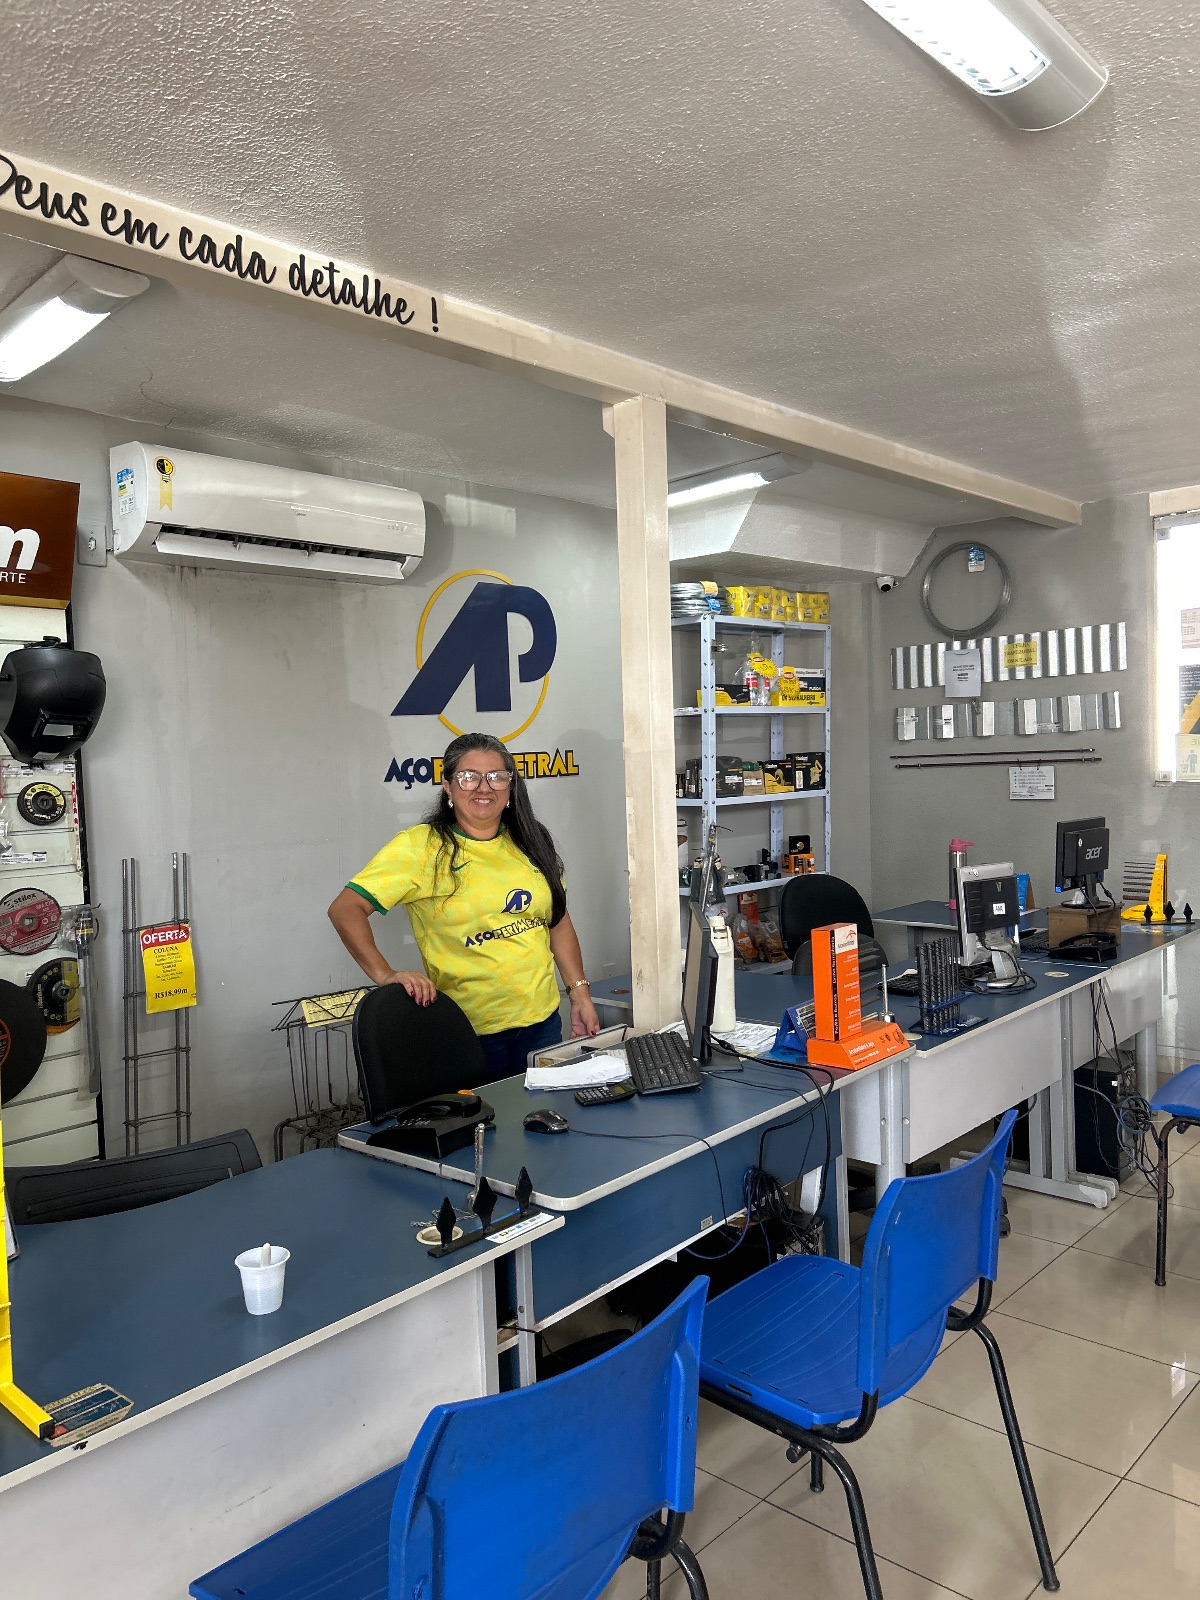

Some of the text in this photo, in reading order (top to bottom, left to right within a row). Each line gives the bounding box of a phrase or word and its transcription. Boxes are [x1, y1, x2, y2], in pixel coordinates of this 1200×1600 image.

[100, 203, 170, 250] em
[179, 226, 277, 284] cada
[288, 254, 415, 325] detalhe
[384, 748, 580, 790] AÇOPETRAL
[1085, 846, 1103, 860] acer
[142, 929, 188, 946] OFERTA
[153, 945, 179, 955] COLUNA
